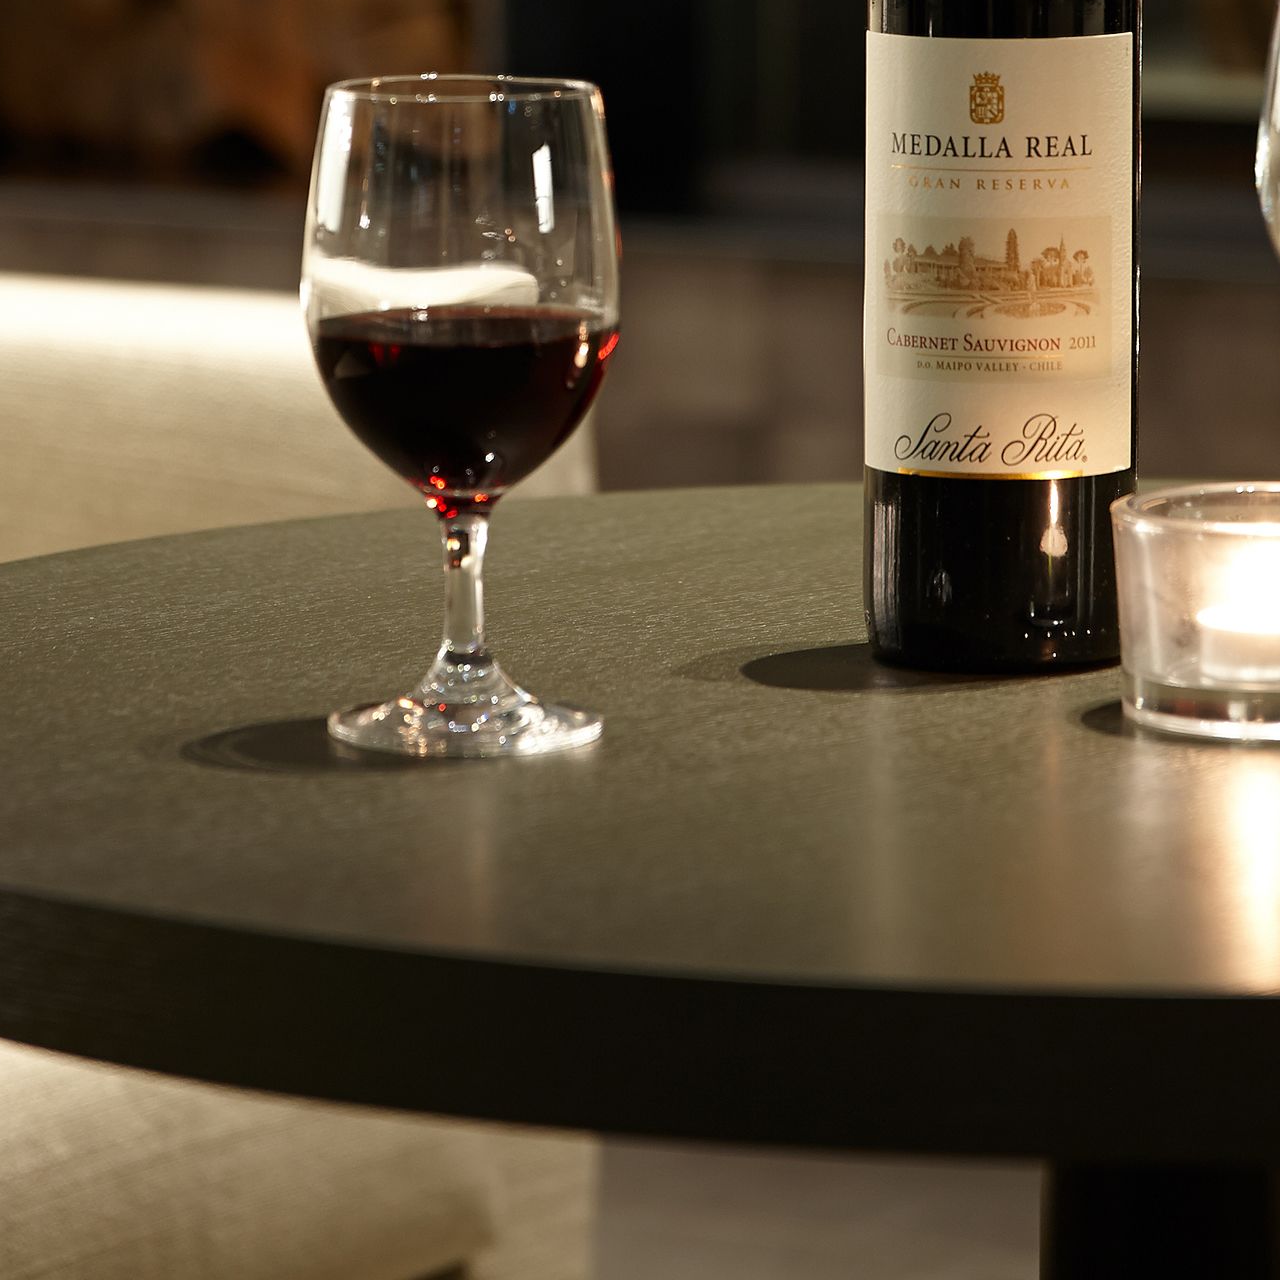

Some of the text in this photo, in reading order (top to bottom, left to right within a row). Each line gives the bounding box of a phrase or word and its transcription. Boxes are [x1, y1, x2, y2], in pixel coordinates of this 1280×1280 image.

[891, 132, 1093, 158] MEDALLA REAL
[908, 175, 1071, 191] GRAN RESERVA
[886, 327, 1097, 352] CABERNET SAUVIGNON 2011
[936, 361, 972, 371] MAIPO
[975, 361, 1020, 372] VALLEY
[1029, 360, 1063, 371] CHILE
[894, 412, 1085, 466] Santa Rita
